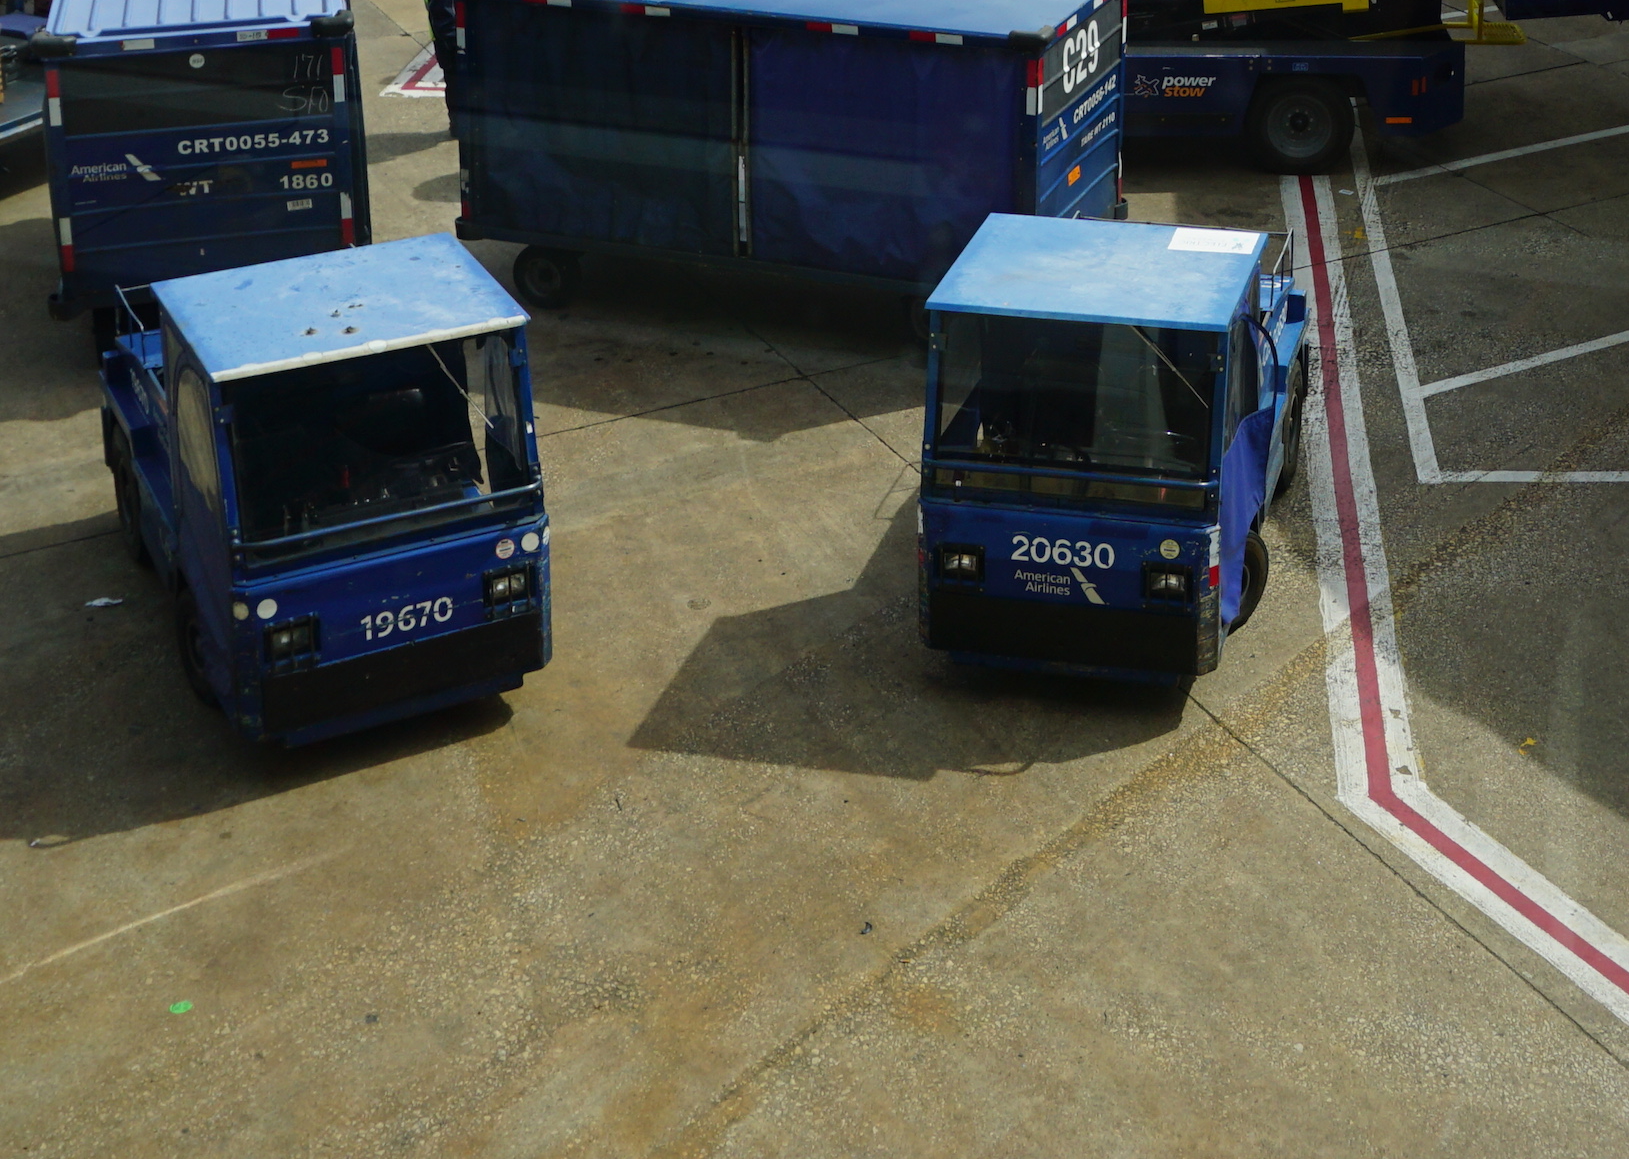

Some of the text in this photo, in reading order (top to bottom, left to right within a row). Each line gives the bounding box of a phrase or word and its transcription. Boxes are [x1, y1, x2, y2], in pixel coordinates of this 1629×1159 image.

[1062, 19, 1100, 94] C29
[1161, 74, 1217, 91] power
[1163, 86, 1206, 98] stow
[177, 128, 330, 155] CRT0055-473
[71, 162, 127, 176] American
[82, 172, 127, 183] Airlines
[279, 172, 334, 190] 1860
[1010, 534, 1116, 570] 20630
[1013, 568, 1071, 586] American
[1024, 580, 1071, 596] Airlines
[360, 596, 454, 641] 19670
